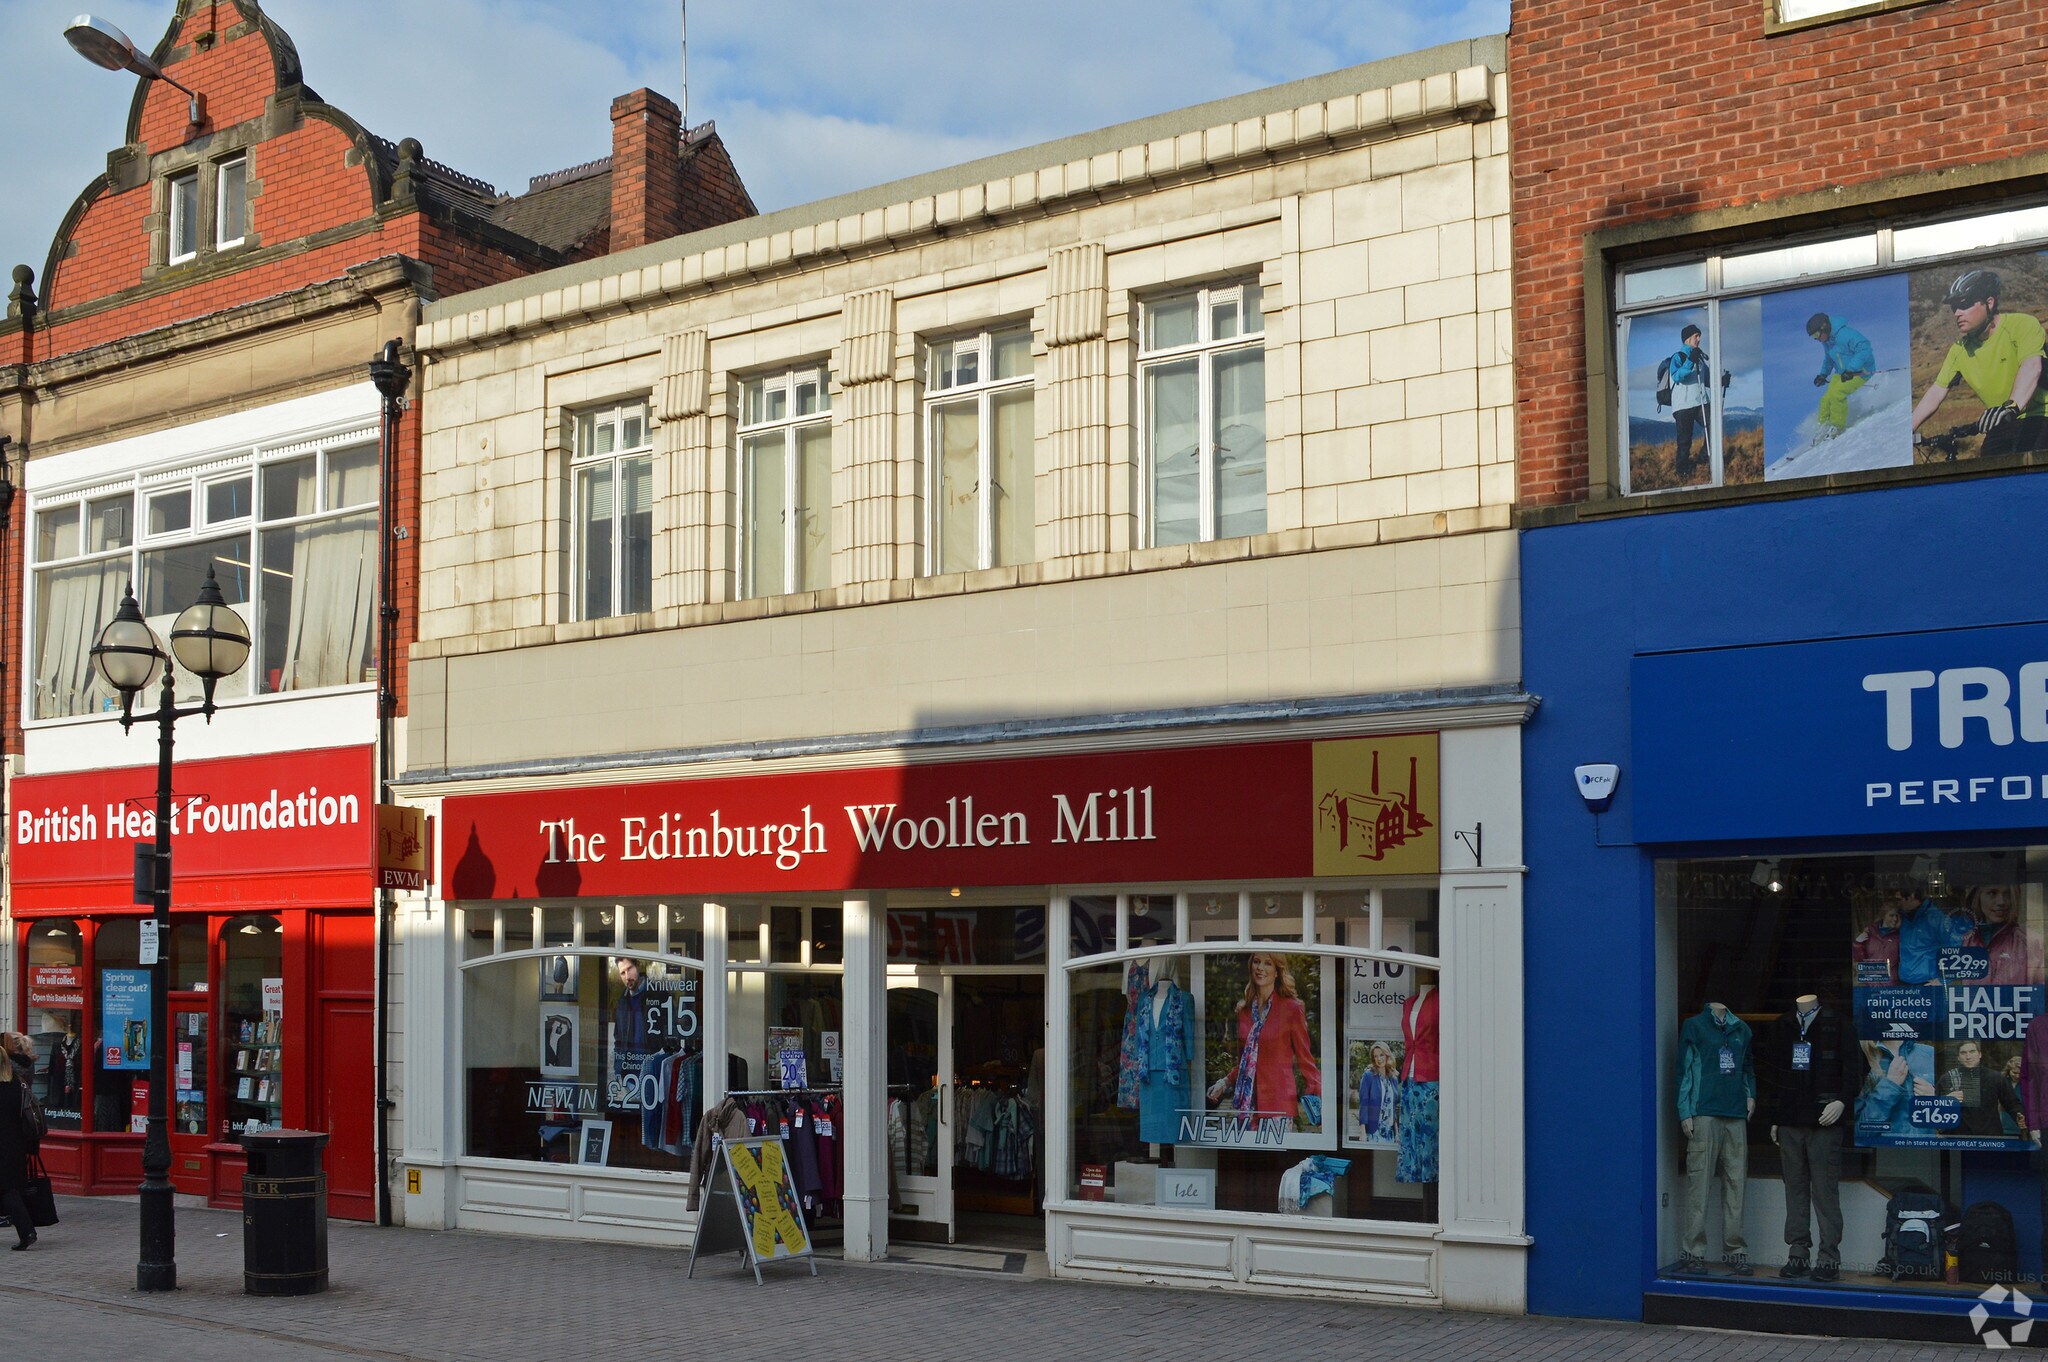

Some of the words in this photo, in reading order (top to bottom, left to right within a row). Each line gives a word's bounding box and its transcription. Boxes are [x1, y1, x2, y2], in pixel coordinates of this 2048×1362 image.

[1867, 764, 2048, 806] PERFO
[17, 803, 97, 845] British
[106, 800, 180, 839] Heat
[187, 786, 358, 834] Foundation
[540, 817, 606, 863] The
[620, 804, 828, 870] Edinburgh
[843, 795, 1030, 852] Woollen
[1051, 785, 1156, 843] Mill
[384, 870, 419, 887] EWM
[1939, 955, 1988, 970] £29.99
[36, 975, 46, 985] We
[46, 975, 57, 985] will
[57, 975, 76, 985] collect
[106, 973, 135, 983] Spring
[646, 977, 698, 991] Knitwear
[1373, 980, 1386, 989] off
[106, 984, 126, 992] clear
[128, 984, 148, 992] out?
[265, 985, 281, 994] Great
[32, 993, 46, 1003] Open
[46, 993, 55, 1002] this
[67, 994, 84, 1004] Holiday
[646, 998, 660, 1006] from
[1353, 991, 1405, 1005] Jackets
[1867, 997, 1889, 1007] rain
[1891, 996, 1932, 1008] jackets
[1949, 987, 2033, 1012] HALF
[647, 996, 698, 1037] £15
[1871, 1009, 1891, 1019] and
[1893, 1009, 1928, 1019] fleece
[1949, 1013, 2033, 1039] PRICE
[626, 1052, 655, 1061] Seasons
[528, 1087, 573, 1110] NEW
[577, 1088, 598, 1110] IN
[608, 1074, 659, 1111] £20
[1934, 1099, 1954, 1107] ONLY
[1912, 1108, 1959, 1123] £16.99
[1178, 1115, 1251, 1144] NEW
[1254, 1117, 1287, 1145] IN
[1175, 1184, 1198, 1197] Isle
[1981, 1268, 2013, 1282] visit
[2016, 1272, 2036, 1283] us
